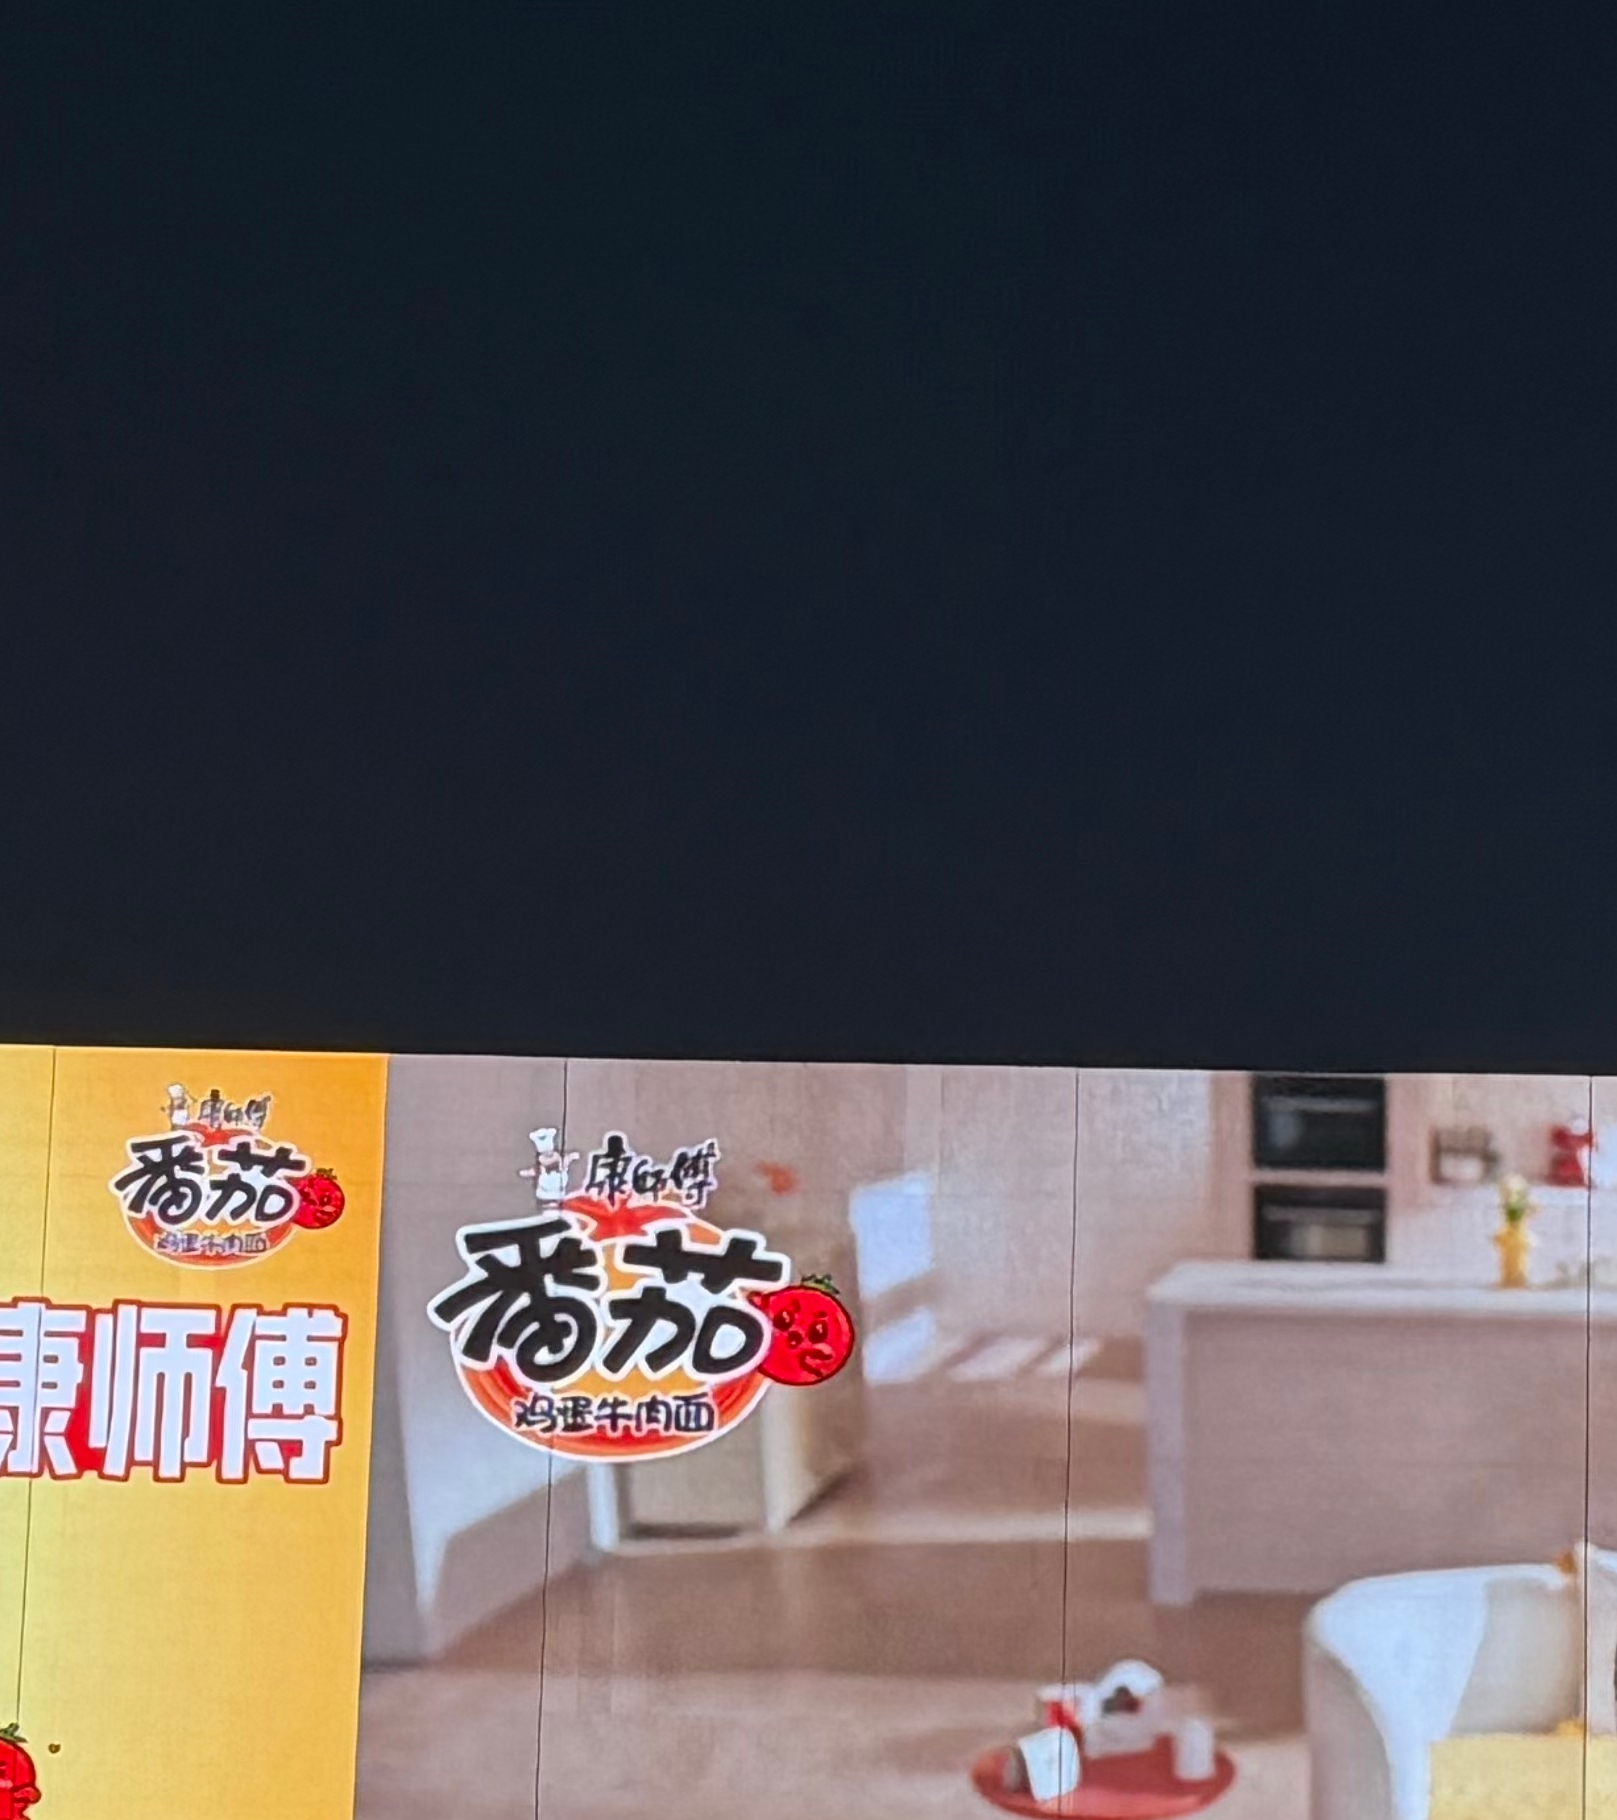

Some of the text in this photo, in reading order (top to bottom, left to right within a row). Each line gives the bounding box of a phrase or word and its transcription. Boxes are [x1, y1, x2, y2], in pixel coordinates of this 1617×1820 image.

[113, 1134, 307, 1226] 番茄
[586, 1133, 720, 1207] 康师傅
[433, 1217, 786, 1382] 番茄
[514, 1394, 716, 1432] 鸡蛋牛肉面
